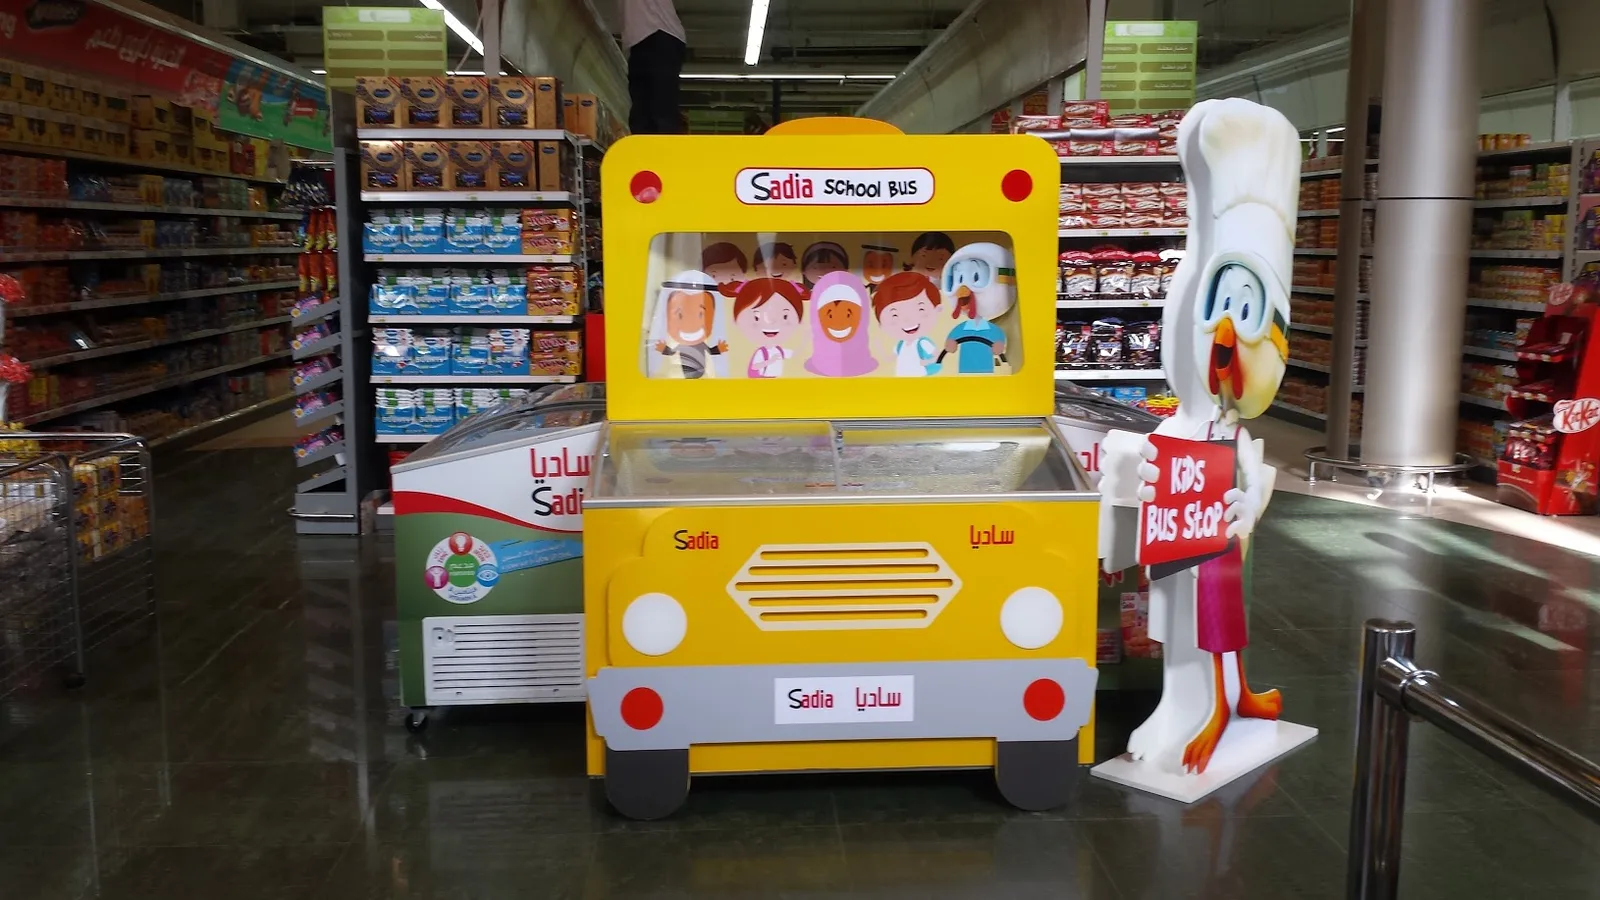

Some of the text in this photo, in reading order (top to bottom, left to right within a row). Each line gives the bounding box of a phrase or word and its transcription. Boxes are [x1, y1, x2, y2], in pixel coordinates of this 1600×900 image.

[751, 172, 814, 200] Sadia
[531, 486, 584, 516] Sadi
[673, 529, 719, 550] Sadia
[970, 524, 1014, 549] ساديا
[788, 688, 834, 709] Sadia
[856, 686, 901, 711] ساديا
